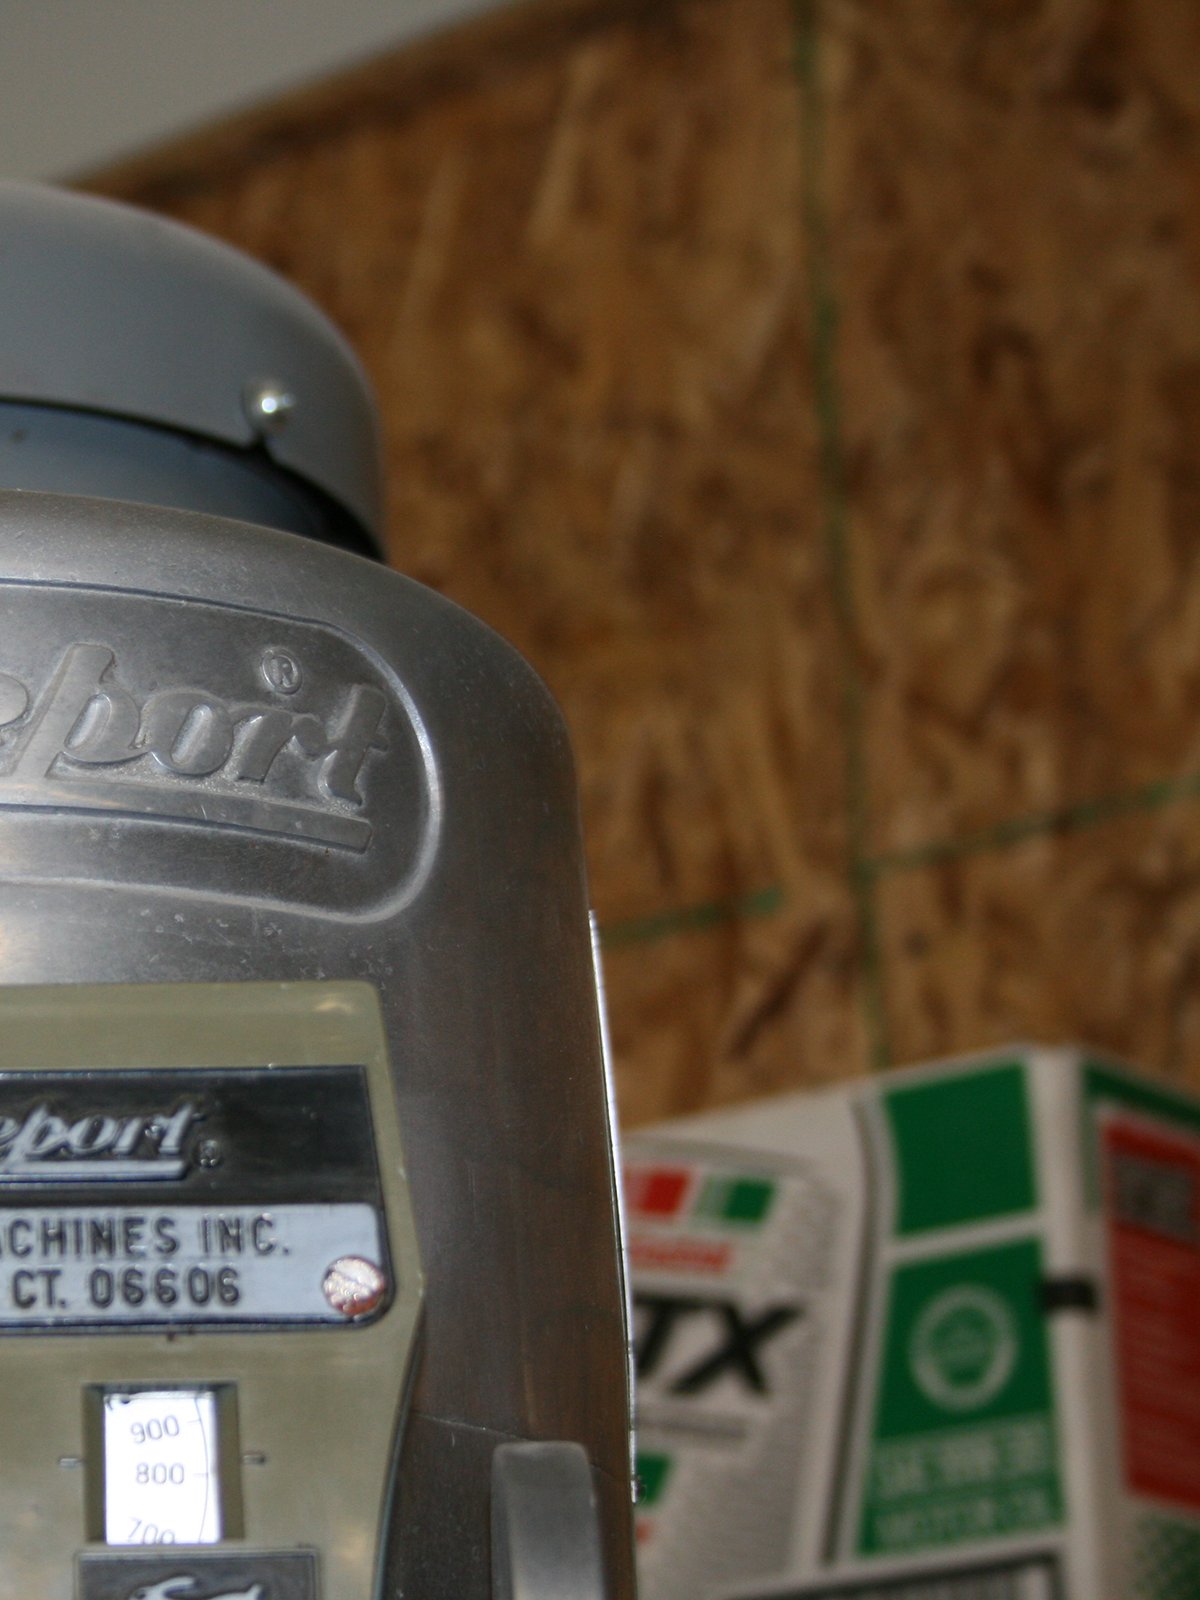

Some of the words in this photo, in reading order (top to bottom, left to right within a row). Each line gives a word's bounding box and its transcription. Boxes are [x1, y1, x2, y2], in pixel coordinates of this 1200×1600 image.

[200, 1211, 291, 1257] INC.
[89, 1264, 241, 1308] 06606
[130, 1414, 180, 1444] 900
[135, 1462, 185, 1485] 800
